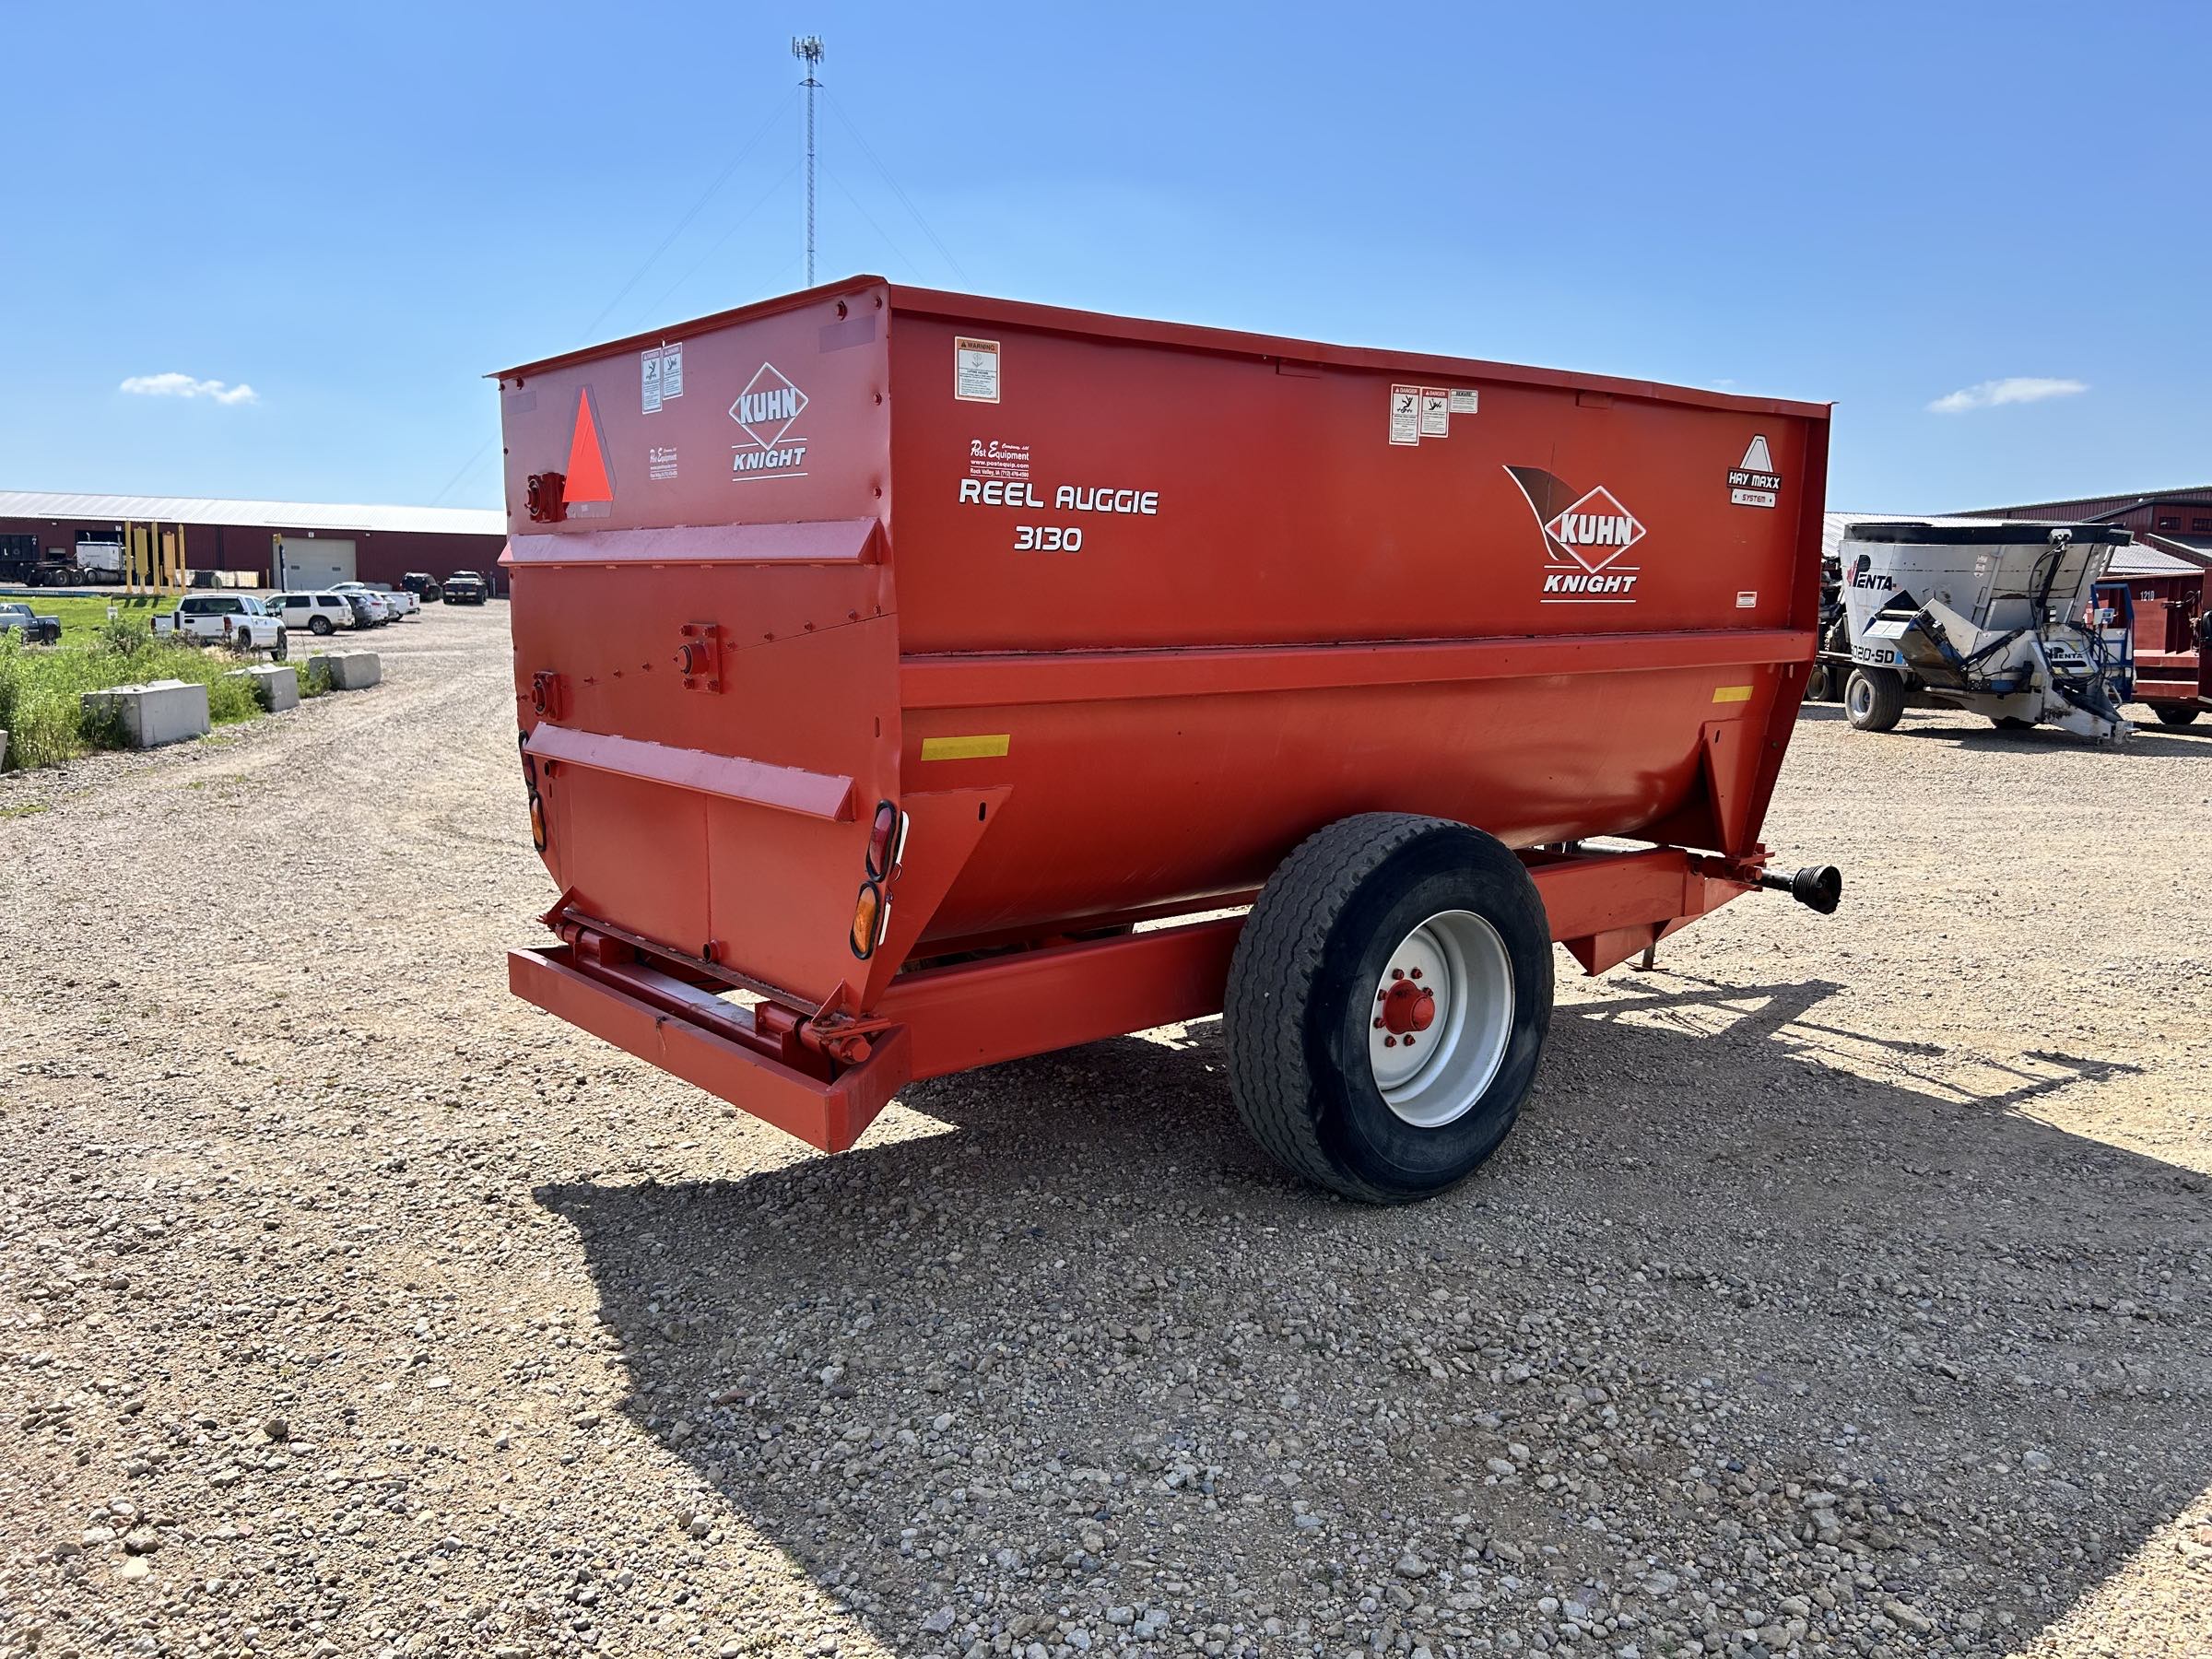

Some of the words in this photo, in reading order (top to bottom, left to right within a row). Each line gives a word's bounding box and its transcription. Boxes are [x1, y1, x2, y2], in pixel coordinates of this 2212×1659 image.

[967, 342, 995, 351] WARNING
[740, 388, 796, 425] KUHN
[733, 448, 806, 472] KNIGHT
[971, 439, 987, 457] Post
[987, 441, 1030, 461] Equipment
[971, 460, 1030, 469] www.postequip.com
[1728, 472, 1749, 485] HAY
[1751, 475, 1780, 488] MAXX
[959, 478, 1044, 508] REEL
[1055, 485, 1159, 515] AUGGIE
[1742, 494, 1766, 502] SYSTEM
[1014, 525, 1083, 552] 3130
[1559, 513, 1633, 546] KUHN
[1853, 554, 1892, 591] PENTA
[1543, 574, 1637, 594] KNIGHT
[2140, 591, 2154, 601] 1210
[1851, 644, 1895, 664] 020-SD
[2053, 647, 2084, 659] PENTA
